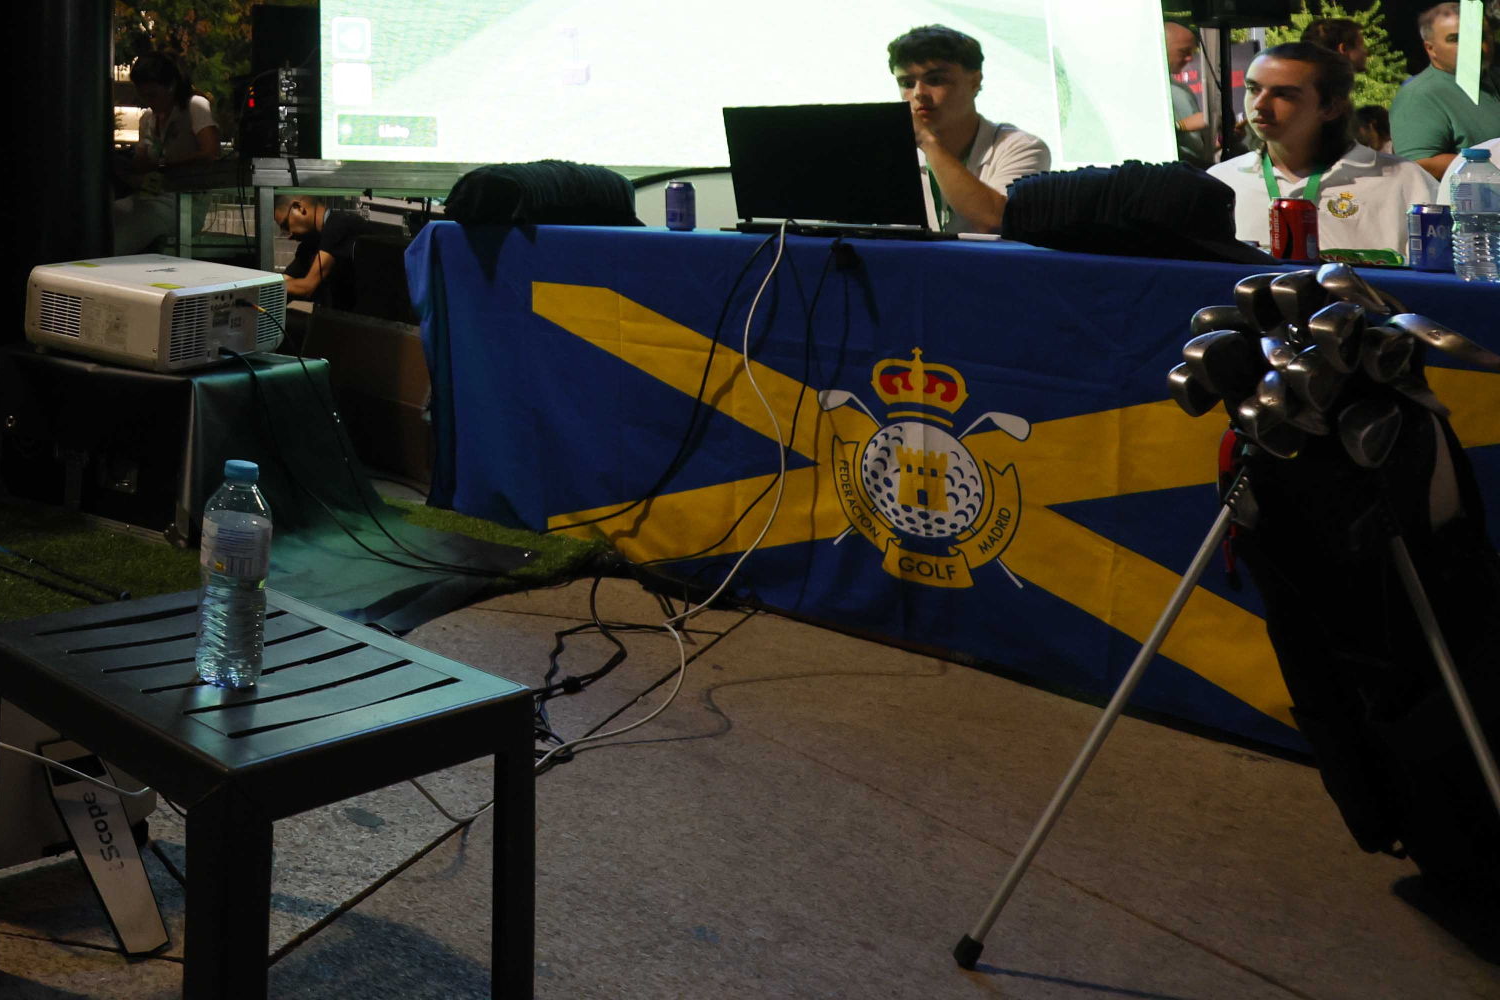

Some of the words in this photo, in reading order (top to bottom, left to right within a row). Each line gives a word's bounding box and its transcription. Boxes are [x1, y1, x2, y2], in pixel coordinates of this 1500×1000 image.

[1426, 224, 1449, 239] AQ
[839, 459, 881, 539] FEDERACION
[977, 506, 1012, 554] MADRID
[898, 556, 957, 580] GOLF
